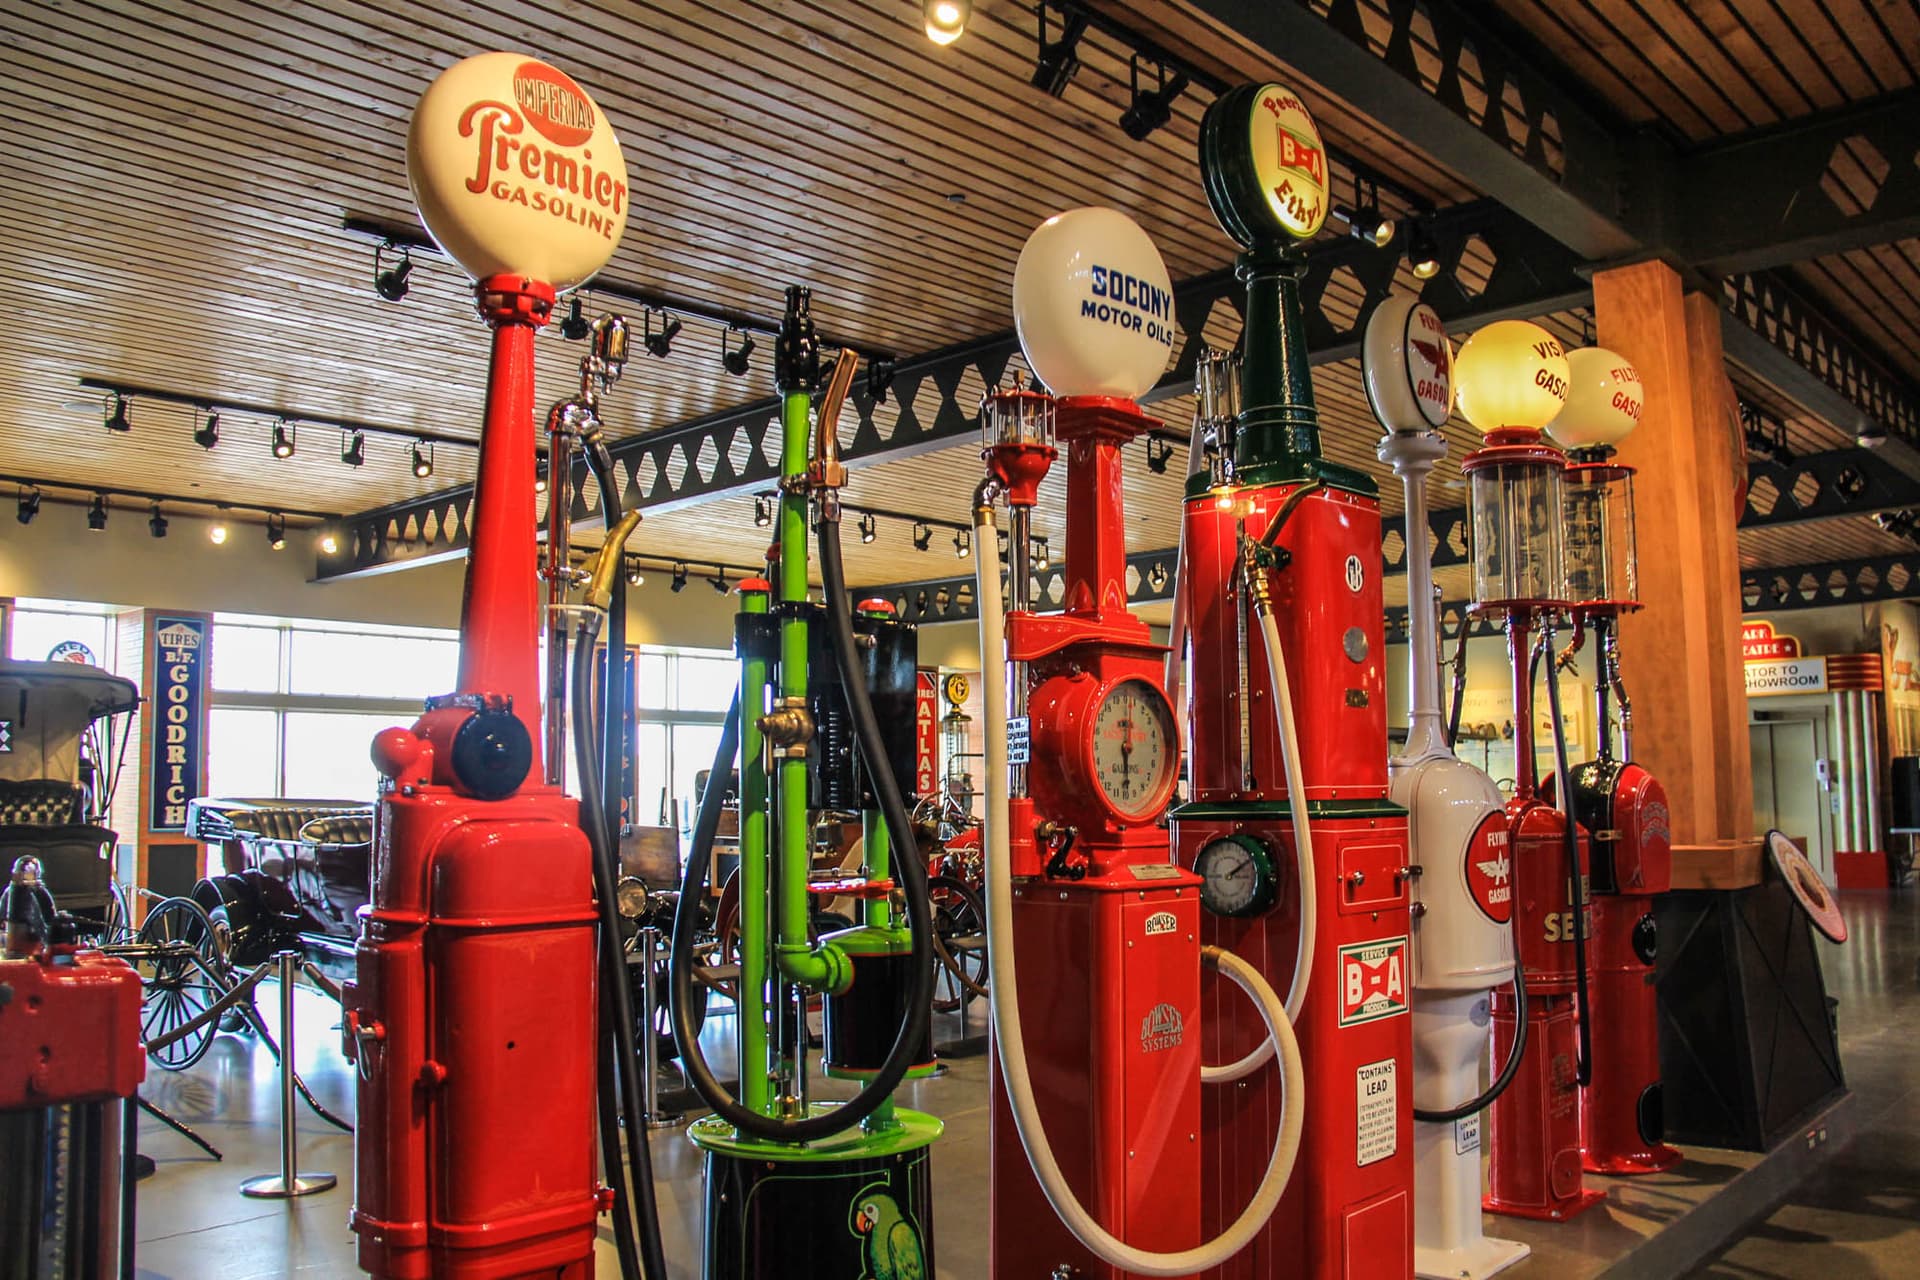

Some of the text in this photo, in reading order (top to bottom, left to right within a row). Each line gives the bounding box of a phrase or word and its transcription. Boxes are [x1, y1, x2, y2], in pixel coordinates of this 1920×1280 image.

[514, 78, 595, 130] IMPERIAL
[458, 99, 626, 215] Premier
[490, 180, 614, 240] GASOLINE
[1274, 179, 1321, 229] Ethyl
[1092, 264, 1170, 322] SOCONY
[1081, 299, 1172, 347] MOTOR OILS
[161, 632, 198, 647] TIRES
[1782, 665, 1798, 675] TO
[164, 665, 190, 825] GOODRICH
[918, 701, 932, 790] ATLAS
[1147, 914, 1175, 932] BOWSER
[1361, 947, 1389, 961] SERVICE
[1141, 1003, 1183, 1041] BOWSER
[1142, 1033, 1182, 1053] SYSTEMS
[1366, 1079, 1387, 1096] LEAD
[1463, 1128, 1477, 1141] LEAD
